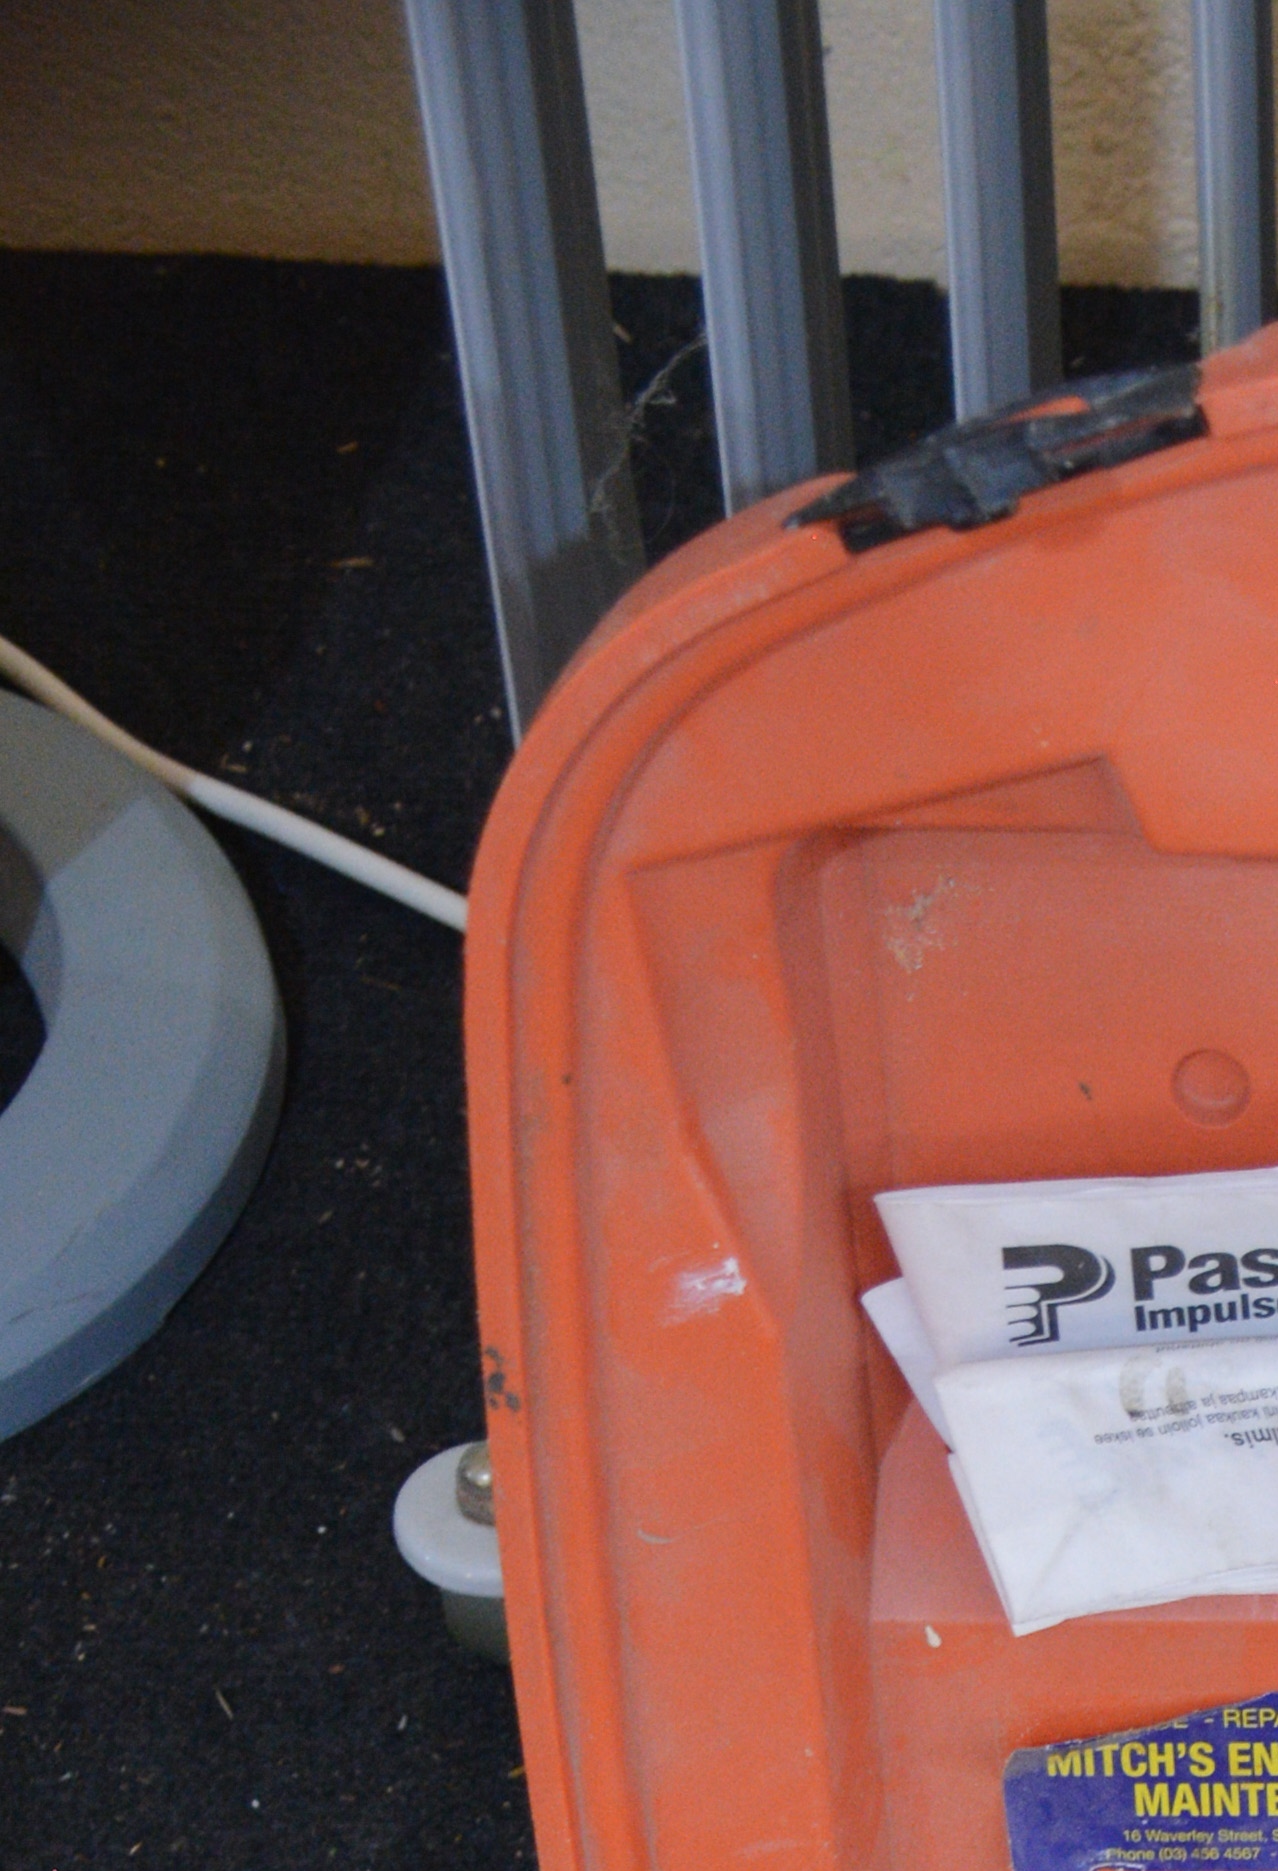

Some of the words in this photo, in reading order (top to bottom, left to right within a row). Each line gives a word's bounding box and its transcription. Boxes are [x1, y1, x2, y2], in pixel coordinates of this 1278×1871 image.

[1046, 1742, 1214, 1777] MITCH'S
[1123, 1829, 1141, 1842] 16
[1145, 1829, 1214, 1843] Waverley
[1218, 1829, 1267, 1842] Street,
[1106, 1848, 1155, 1860] Phone
[1159, 1848, 1187, 1862] (03)
